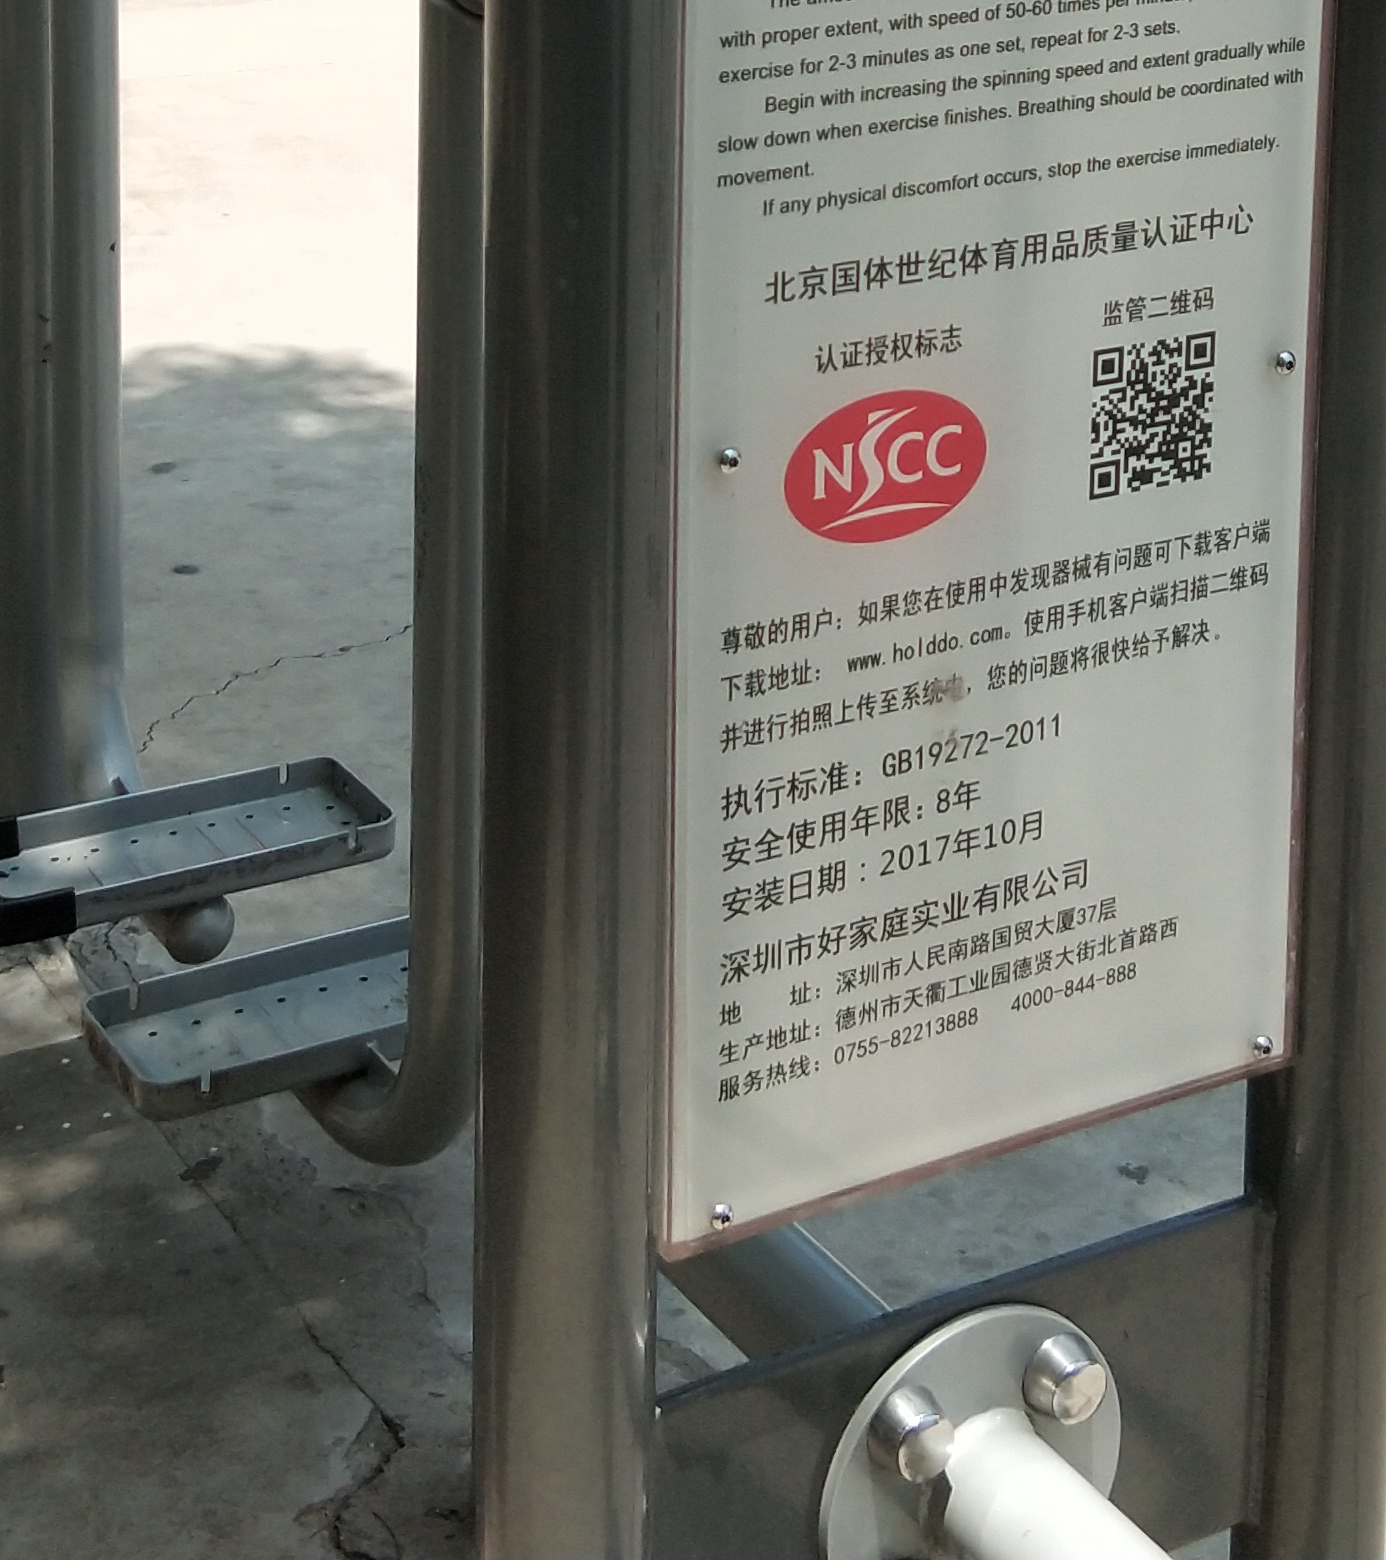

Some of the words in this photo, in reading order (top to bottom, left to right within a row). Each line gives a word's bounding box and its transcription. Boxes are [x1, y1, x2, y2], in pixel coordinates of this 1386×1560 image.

[719, 62, 794, 83] exercise
[800, 58, 823, 74] for
[829, 53, 856, 71] 2-3
[862, 48, 929, 67] minutes
[935, 47, 954, 59] as
[960, 43, 990, 57] one
[996, 36, 1025, 53] set,
[1031, 30, 1082, 51] repeat
[1088, 27, 1108, 42] for
[1113, 23, 1138, 40] 2-3
[1144, 21, 1180, 36] sets.
[720, 30, 755, 48] with
[762, 27, 820, 48] proper
[825, 18, 882, 37] extent,
[889, 13, 922, 30] with
[929, 8, 979, 30] speed
[985, 4, 1001, 21] of
[1006, 0, 1052, 18] 50-60
[718, 136, 758, 153] slow
[764, 131, 810, 147] down
[816, 124, 862, 140] when
[869, 114, 938, 134] exercise
[945, 106, 1011, 125] finishes.
[1019, 95, 1094, 116] Breathing
[1100, 86, 1151, 106] should
[1157, 85, 1175, 99] be
[1181, 72, 1269, 96] coordinated
[1274, 68, 1303, 85] with
[765, 93, 814, 114] Begin
[820, 88, 854, 106] with
[861, 79, 946, 101] increasing
[952, 76, 977, 91] the
[983, 69, 1050, 90] spinning
[1056, 59, 1103, 82] speed
[1109, 55, 1137, 73] and
[1143, 50, 1189, 69] extent
[1194, 42, 1264, 67] gradually
[1266, 37, 1306, 56] while
[717, 162, 814, 187] movement.
[763, 199, 774, 216] If
[780, 198, 811, 215] any
[817, 184, 886, 213] physical
[892, 174, 978, 198] discomfort
[984, 169, 1041, 186] occurs,
[1048, 163, 1081, 178] stop
[1087, 157, 1111, 172] the
[1117, 148, 1181, 168] exercise
[1186, 135, 1279, 159] immediately.
[765, 204, 1253, 304] 北京国体世纪体育用品质量认证中心
[1103, 287, 1213, 327] 监管二维码
[815, 324, 962, 373] 认证授权标志
[813, 406, 963, 515] NSCC
[721, 859, 1087, 986] 深圳市好家庭实业有限公司
